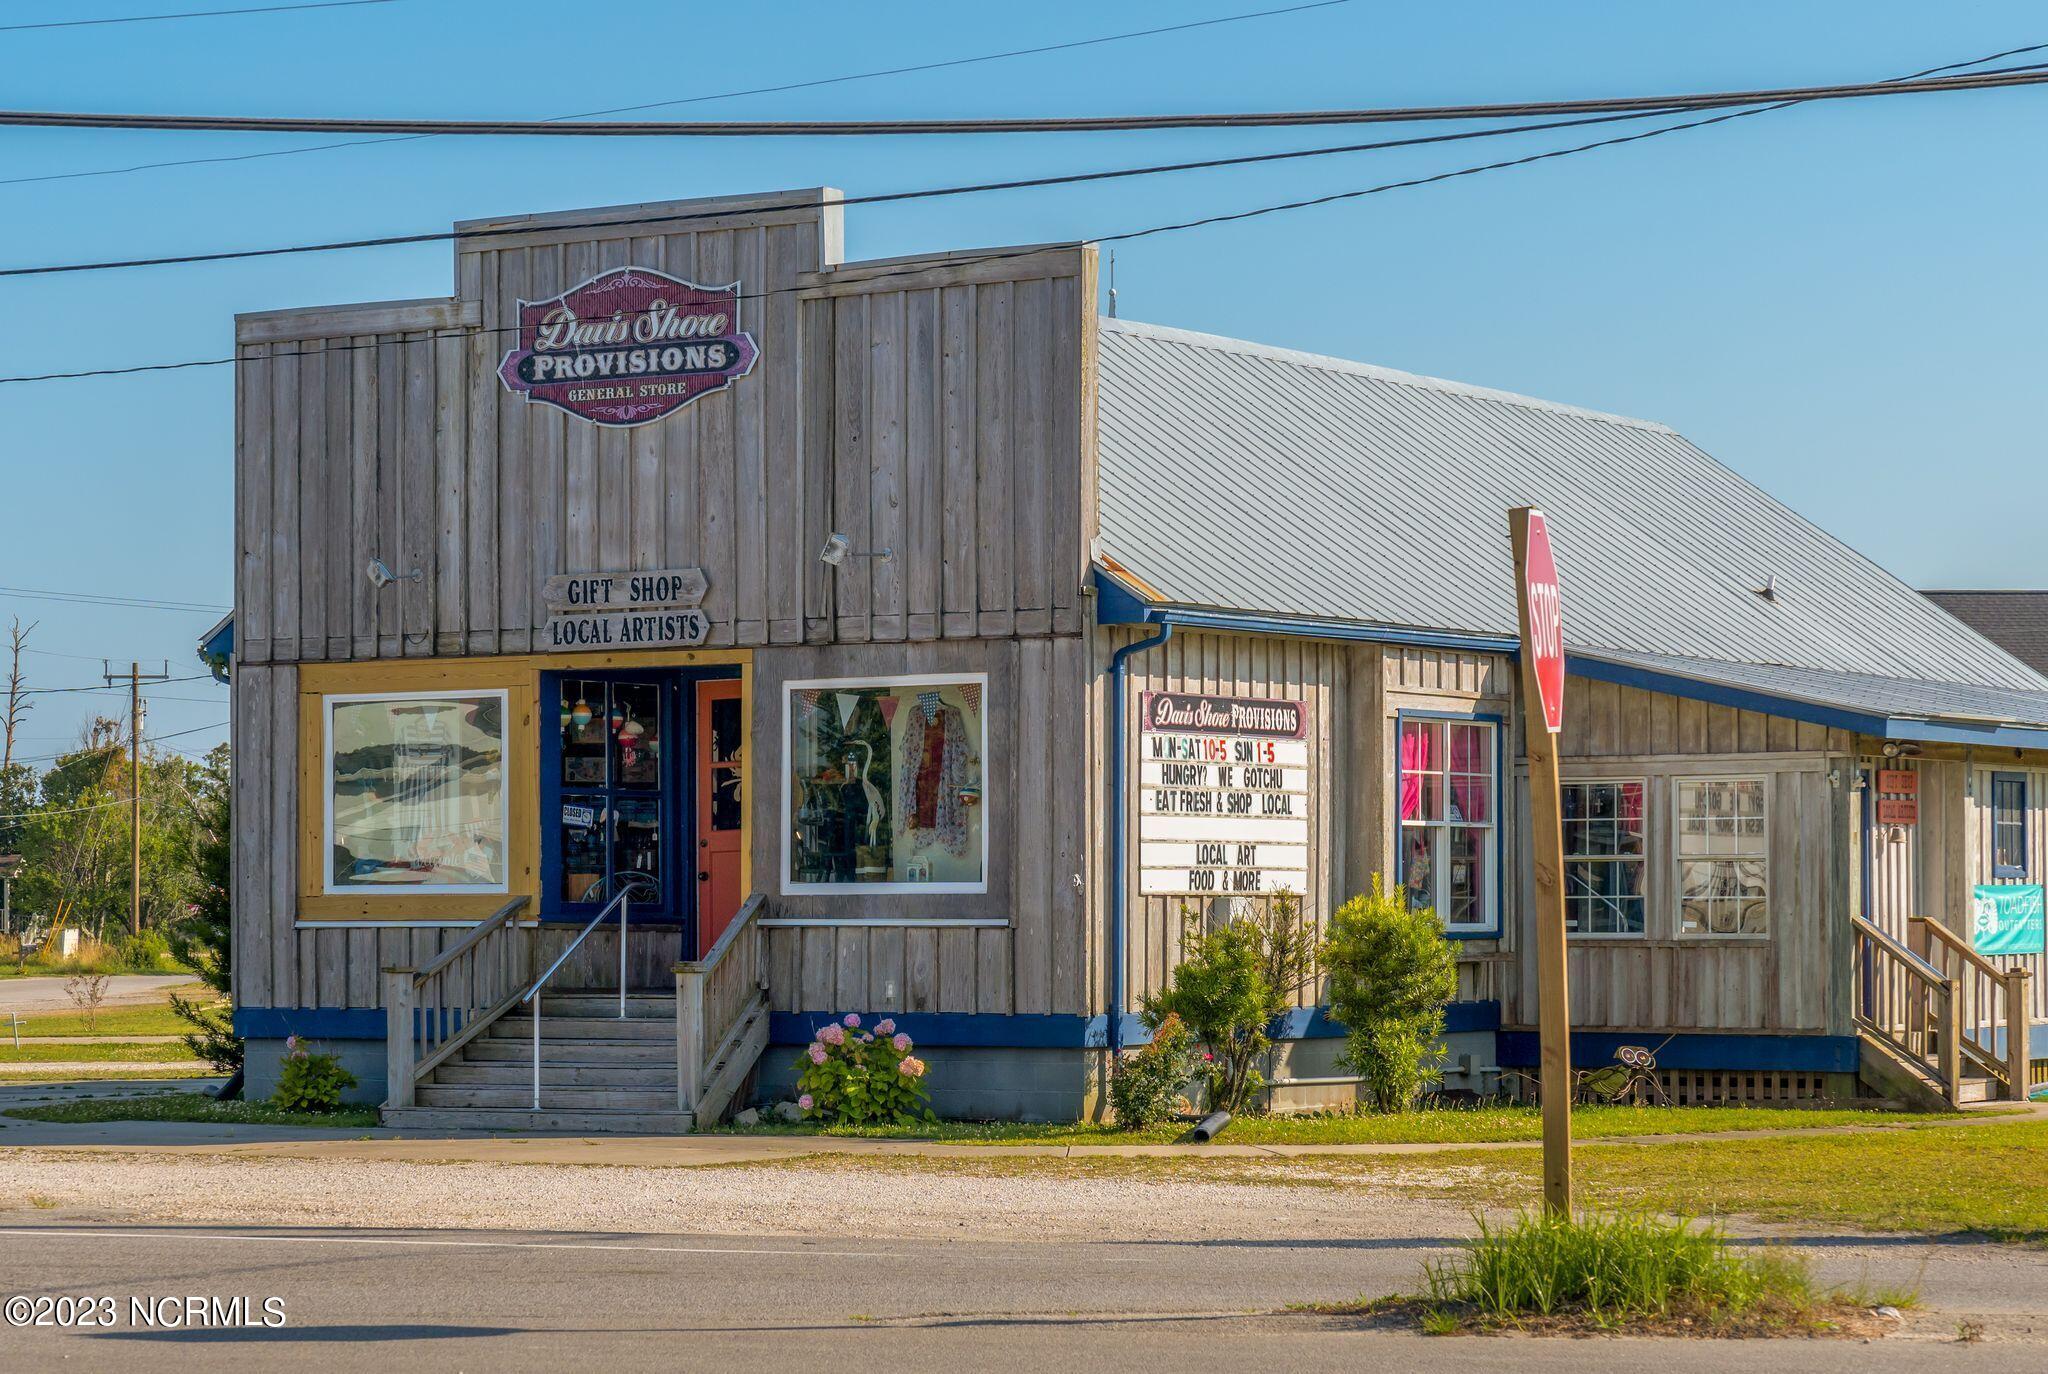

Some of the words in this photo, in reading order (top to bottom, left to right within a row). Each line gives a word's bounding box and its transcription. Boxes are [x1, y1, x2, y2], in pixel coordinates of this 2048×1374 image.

[534, 307, 630, 351] Davis
[633, 298, 729, 344] Shore
[532, 343, 727, 382] PROVISIONS
[568, 386, 634, 402] GENERAL
[640, 382, 686, 398] STORE
[567, 578, 613, 605] GIFT
[630, 575, 682, 602] SHOP
[553, 618, 612, 646] LOCAL
[619, 614, 700, 643] ARTISTS
[1531, 582, 1559, 659] STOP
[1155, 697, 1194, 726] Davis
[1195, 699, 1230, 728] Shore
[1231, 703, 1297, 732] PROVISIONS
[1161, 764, 1208, 787] HUNGRY?
[1218, 766, 1233, 788] WE
[1244, 767, 1283, 789] GOTCHU
[1156, 790, 1177, 812] EAT
[1180, 791, 1212, 813] FRESH
[1216, 794, 1223, 813] &
[1227, 793, 1252, 814] SHOP
[1262, 794, 1292, 815] LOCAL
[1196, 843, 1228, 866] LOCAL
[1237, 845, 1256, 866] ART
[1189, 870, 1214, 891] FOOD
[1222, 871, 1229, 891] &
[1233, 871, 1261, 892] MORE
